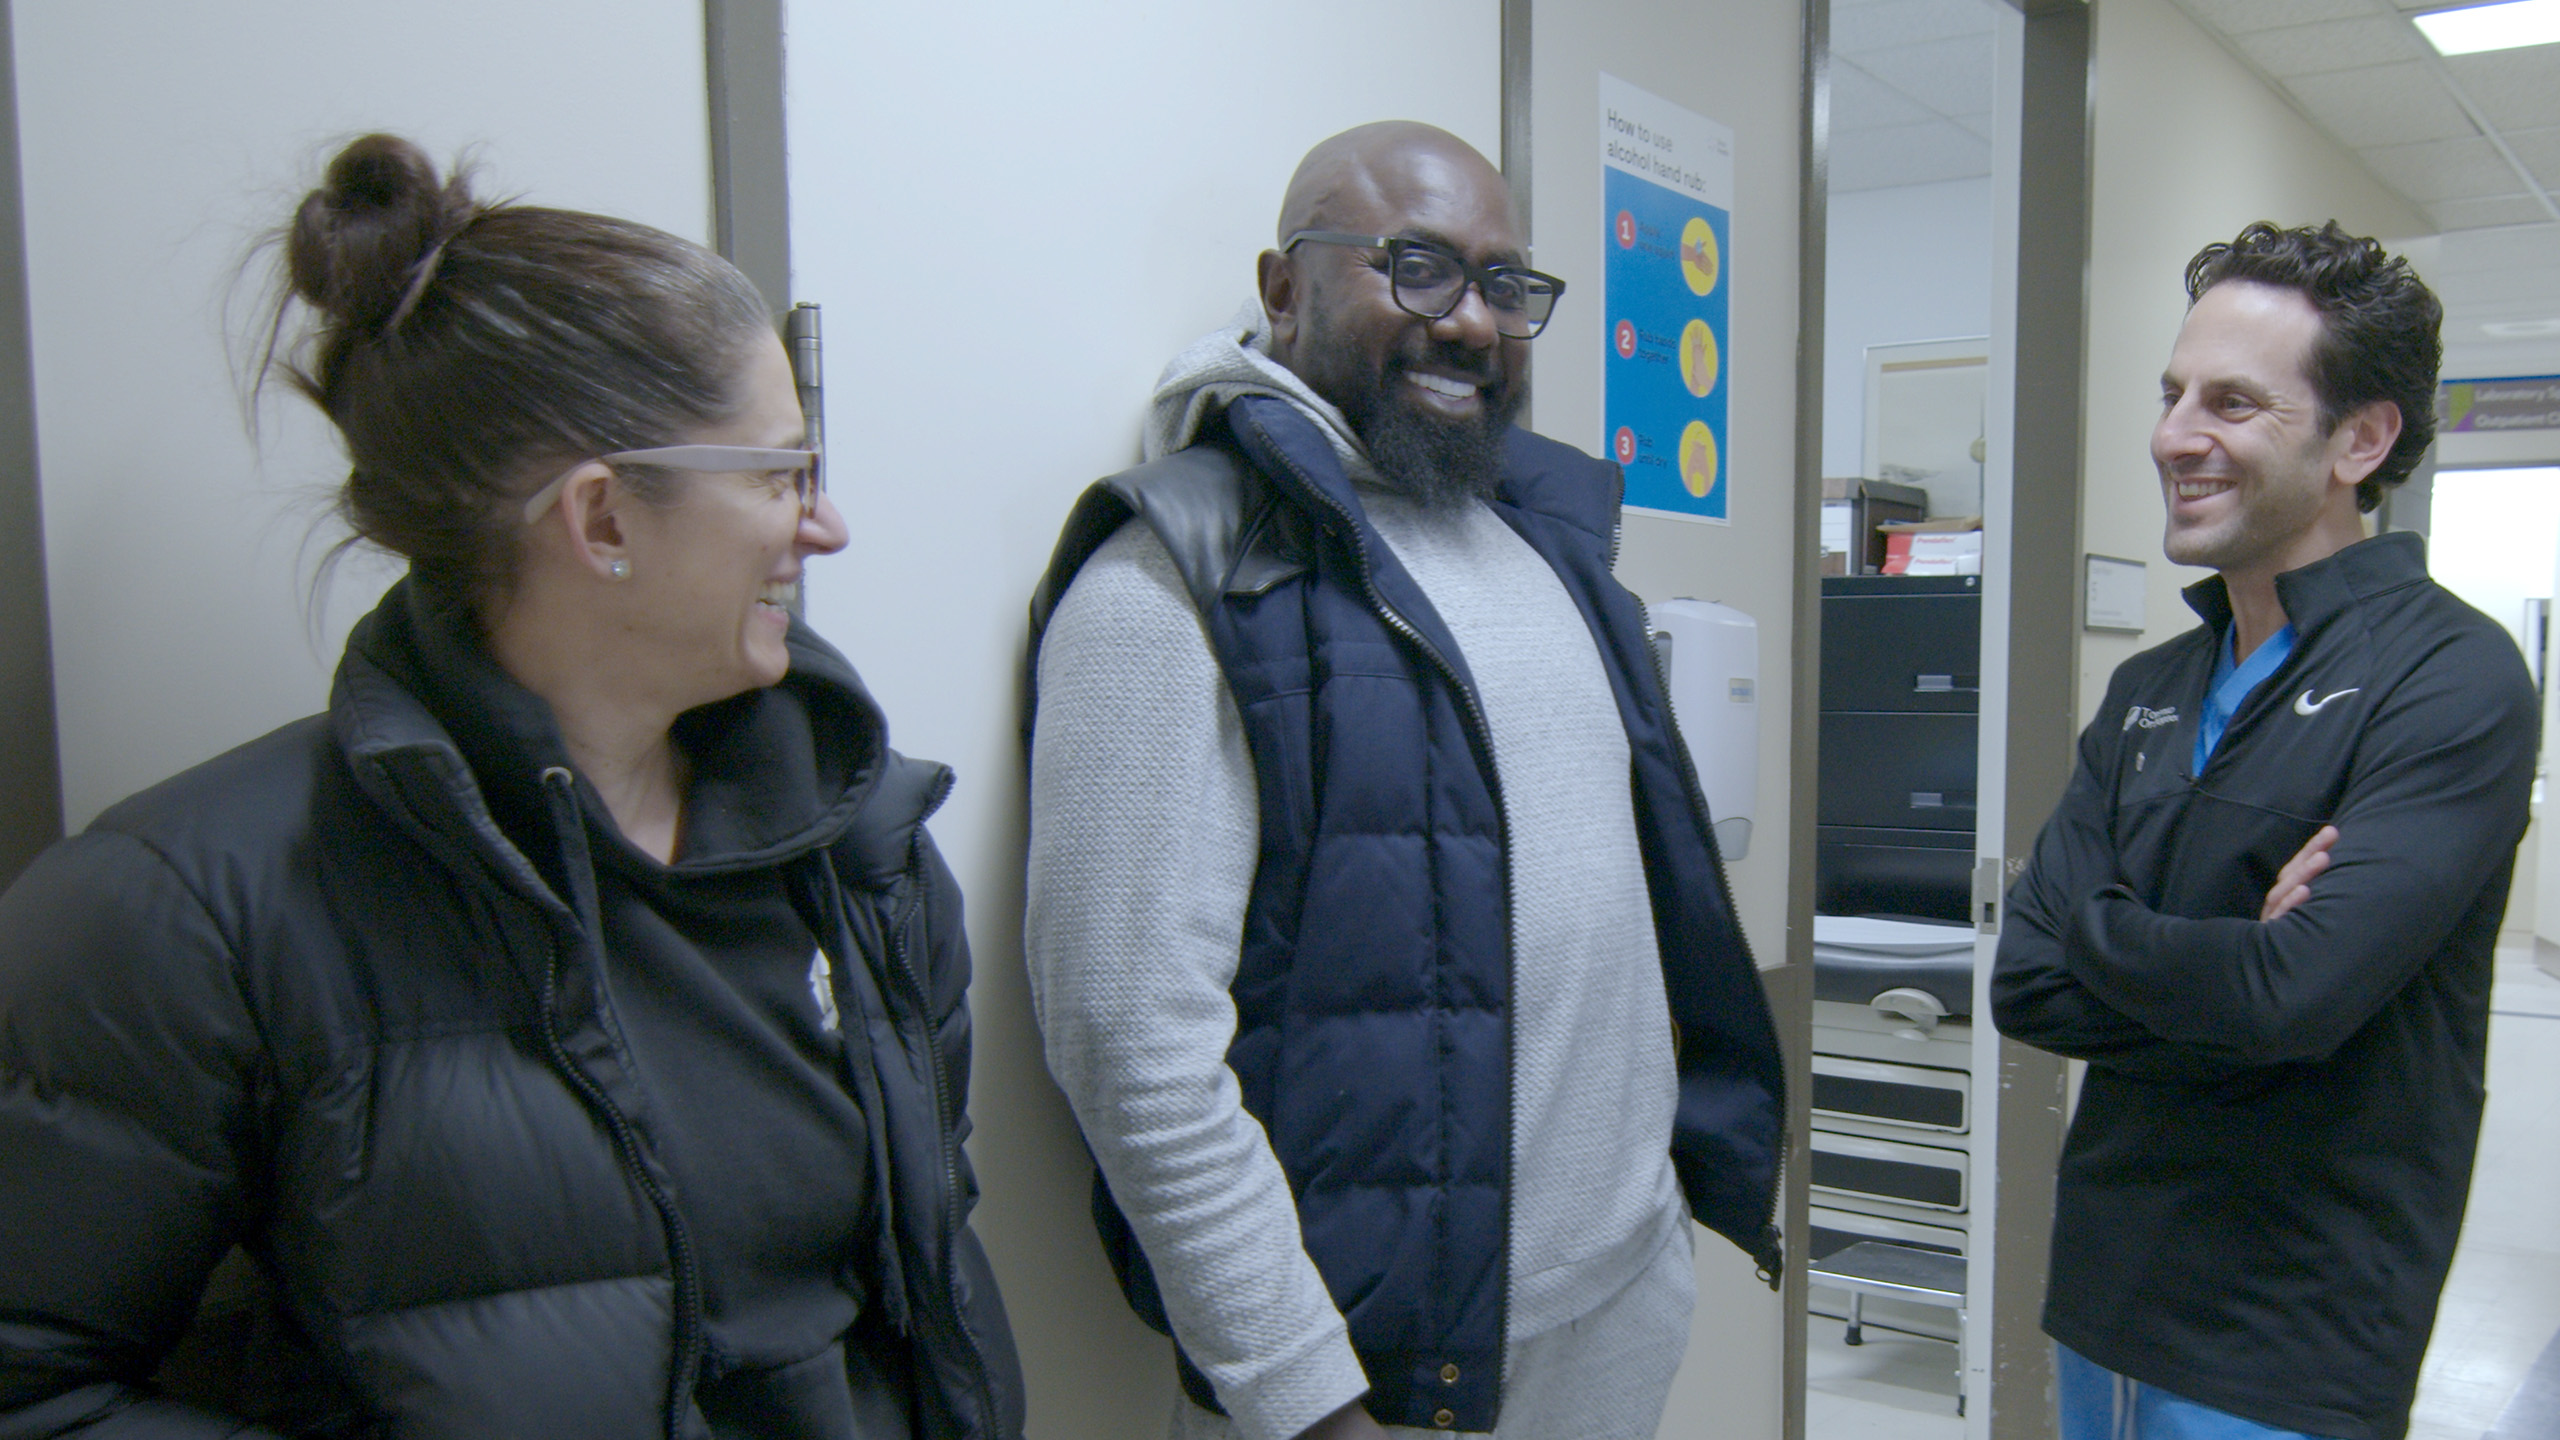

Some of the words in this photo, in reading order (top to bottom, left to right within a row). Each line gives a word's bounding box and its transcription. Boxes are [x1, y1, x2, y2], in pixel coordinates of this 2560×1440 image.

[1606, 107, 1635, 138] How
[1638, 122, 1650, 144] to
[1653, 132, 1674, 153] use
[1606, 139, 1651, 171] alcohol
[1653, 155, 1682, 184] hand
[1621, 220, 1631, 240] 1
[1621, 329, 1631, 350] 2
[1621, 435, 1631, 456] 3
